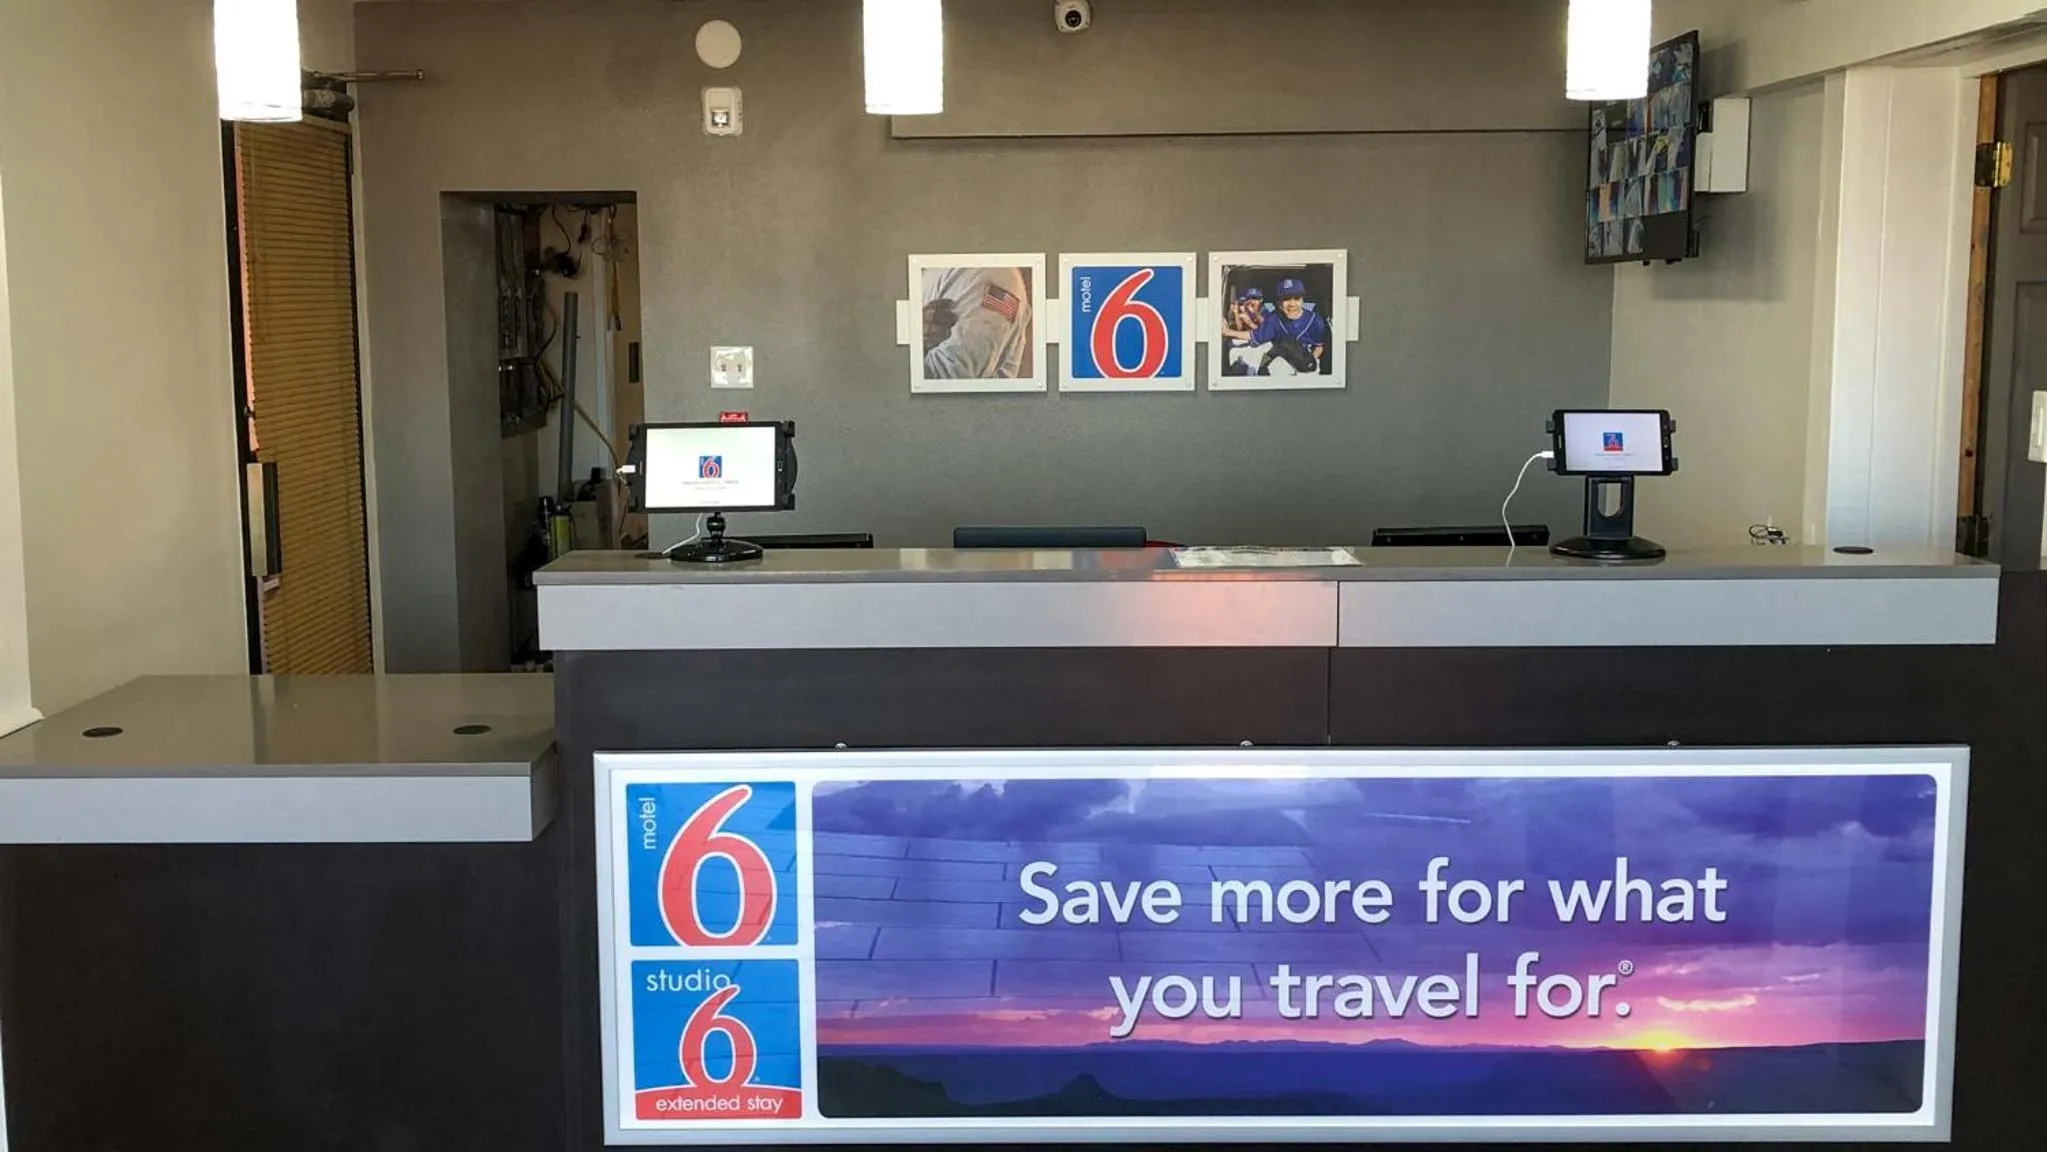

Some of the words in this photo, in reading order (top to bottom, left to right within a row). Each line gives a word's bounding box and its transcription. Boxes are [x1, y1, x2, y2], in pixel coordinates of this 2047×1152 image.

[1080, 276, 1092, 312] motel
[1090, 268, 1169, 379] 6
[638, 797, 657, 850] motel
[658, 784, 777, 947] 6
[1018, 860, 1183, 925] Save
[1210, 878, 1393, 924] more
[1418, 856, 1525, 923] for
[1548, 856, 1728, 923] what
[646, 968, 731, 992] studio
[1108, 974, 1243, 1038] you
[1269, 952, 1480, 1019] travel
[679, 984, 757, 1087] 6
[655, 1095, 741, 1112] extended
[747, 1095, 784, 1114] stay
